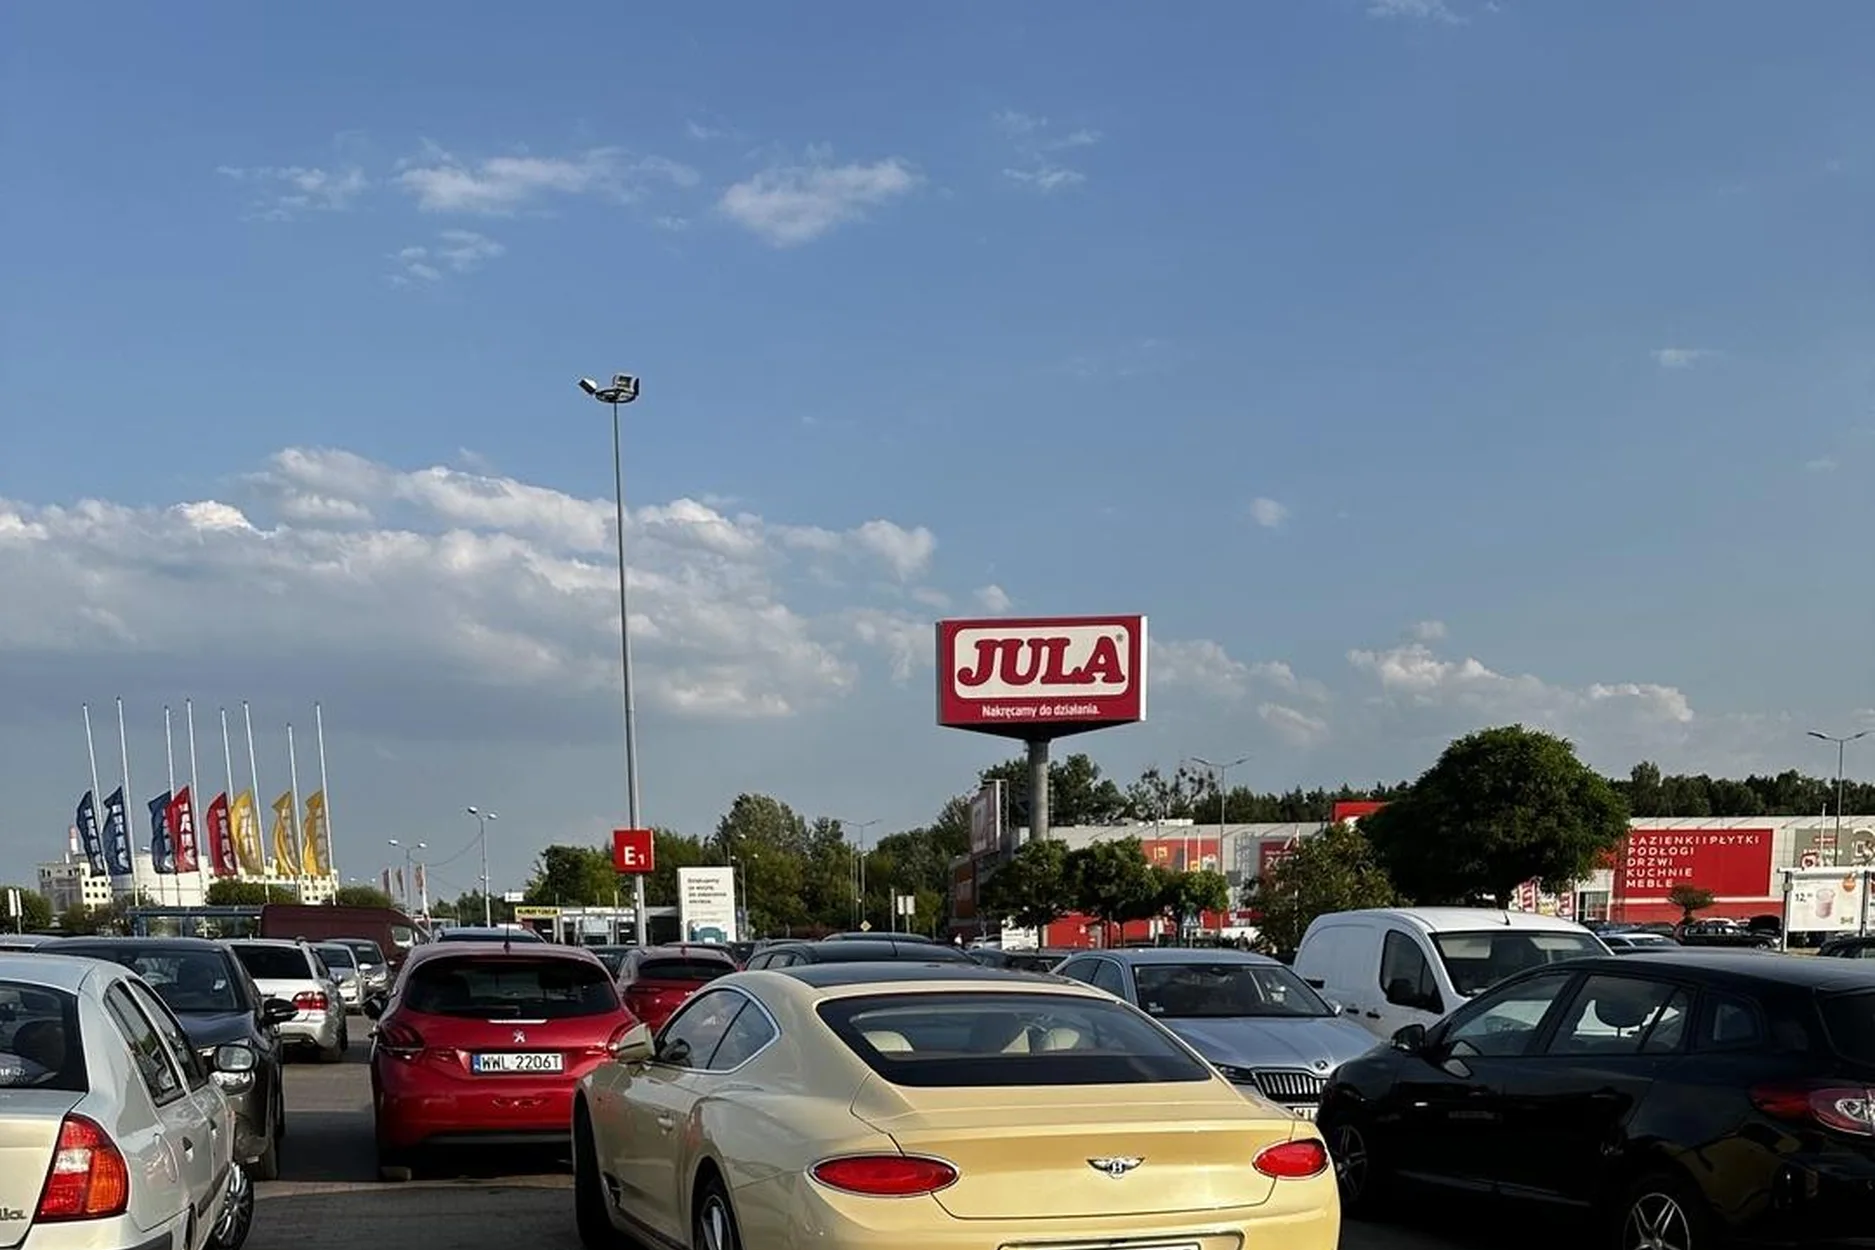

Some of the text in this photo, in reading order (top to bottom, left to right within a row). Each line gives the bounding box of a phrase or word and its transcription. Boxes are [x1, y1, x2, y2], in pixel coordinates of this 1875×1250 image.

[957, 635, 1126, 687] JULA
[982, 702, 1100, 719] Nakręcamy do działania.
[1629, 836, 1698, 845] ŁAZIENKI
[1709, 835, 1759, 844] PŁYTKI
[624, 846, 645, 865] E1
[1628, 847, 1694, 856] PODŁOGI
[1627, 857, 1673, 867] DRZWI
[1626, 868, 1693, 878] KUCHNIE
[1626, 879, 1673, 888] MEBLE
[482, 1055, 559, 1070] WWL 2206T
